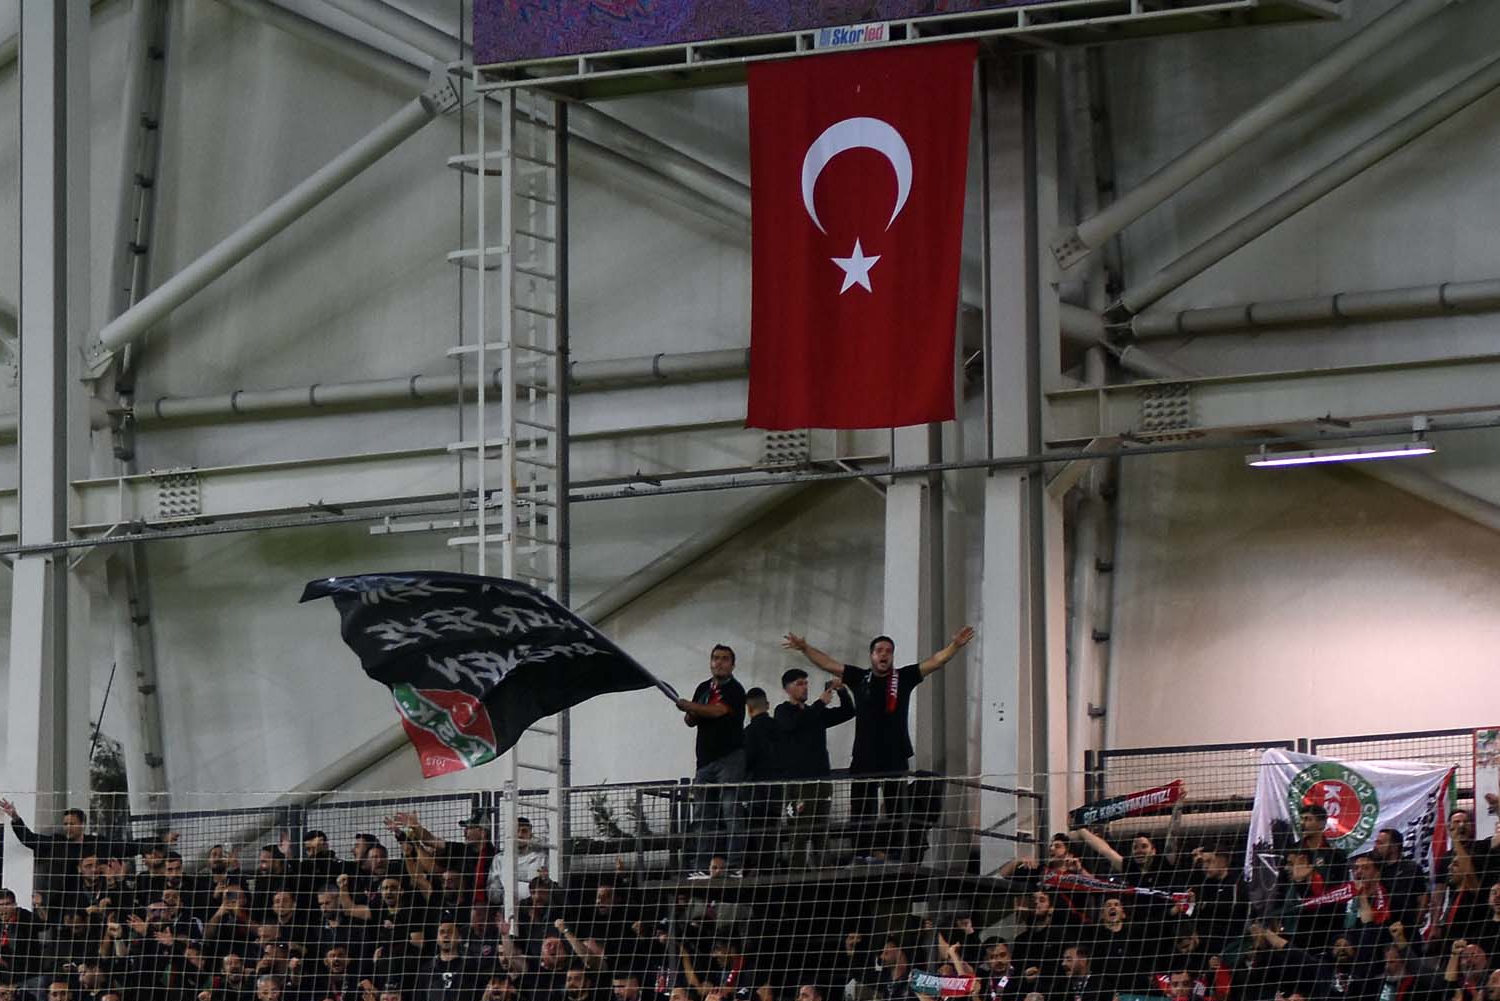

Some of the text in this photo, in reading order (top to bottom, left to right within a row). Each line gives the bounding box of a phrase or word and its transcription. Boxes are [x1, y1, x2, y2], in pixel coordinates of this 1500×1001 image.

[832, 24, 885, 46] Skorled
[1341, 770, 1373, 800] 1912
[1323, 784, 1342, 833] KSK
